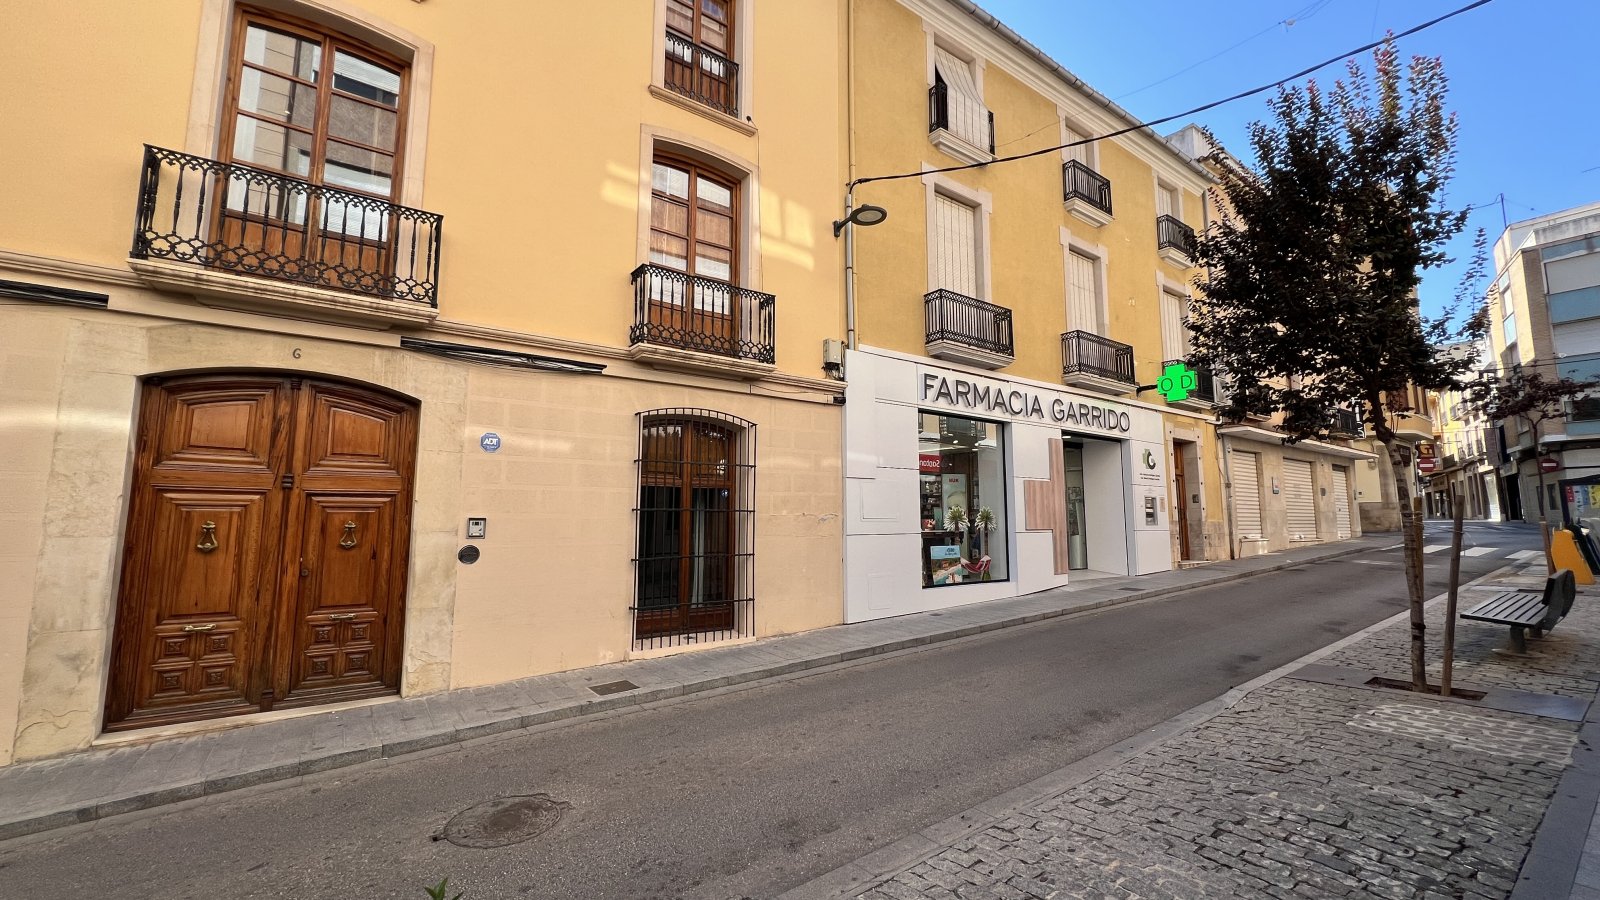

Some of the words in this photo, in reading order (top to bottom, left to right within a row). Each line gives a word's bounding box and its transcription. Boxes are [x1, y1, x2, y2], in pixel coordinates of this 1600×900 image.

[921, 373, 1045, 419] FARMACIA
[1052, 398, 1130, 432] GARRIDO
[483, 438, 498, 446] ADT
